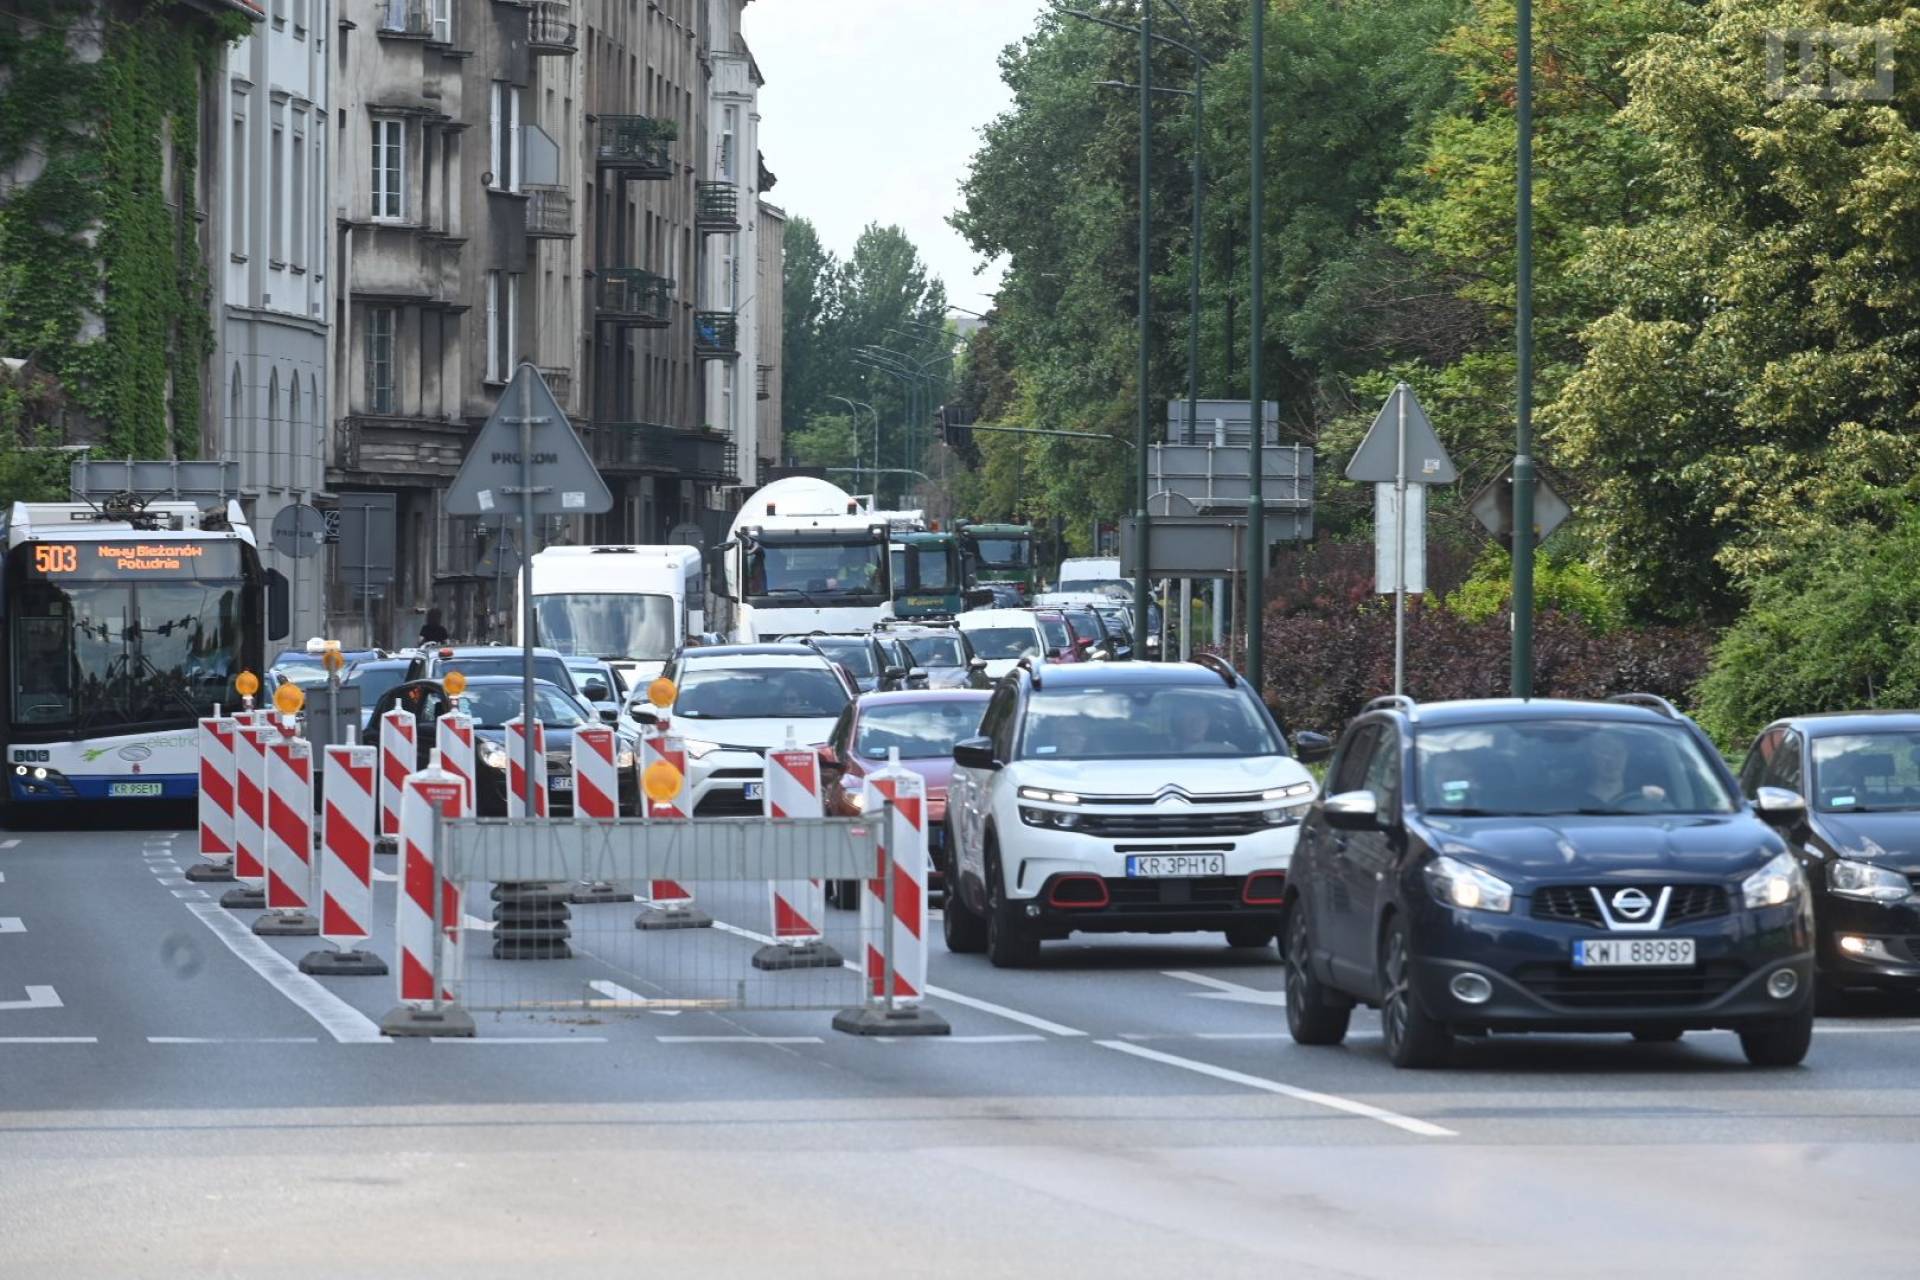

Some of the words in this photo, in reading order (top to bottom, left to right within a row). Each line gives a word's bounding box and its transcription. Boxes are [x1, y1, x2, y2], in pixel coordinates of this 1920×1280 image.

[35, 545, 77, 572] 503
[98, 545, 136, 559] Nowy
[114, 783, 128, 794] KR
[1138, 856, 1161, 874] KR
[1166, 855, 1220, 874] 3PH16
[1585, 943, 1621, 963] KWI
[1631, 942, 1692, 962] 88989
